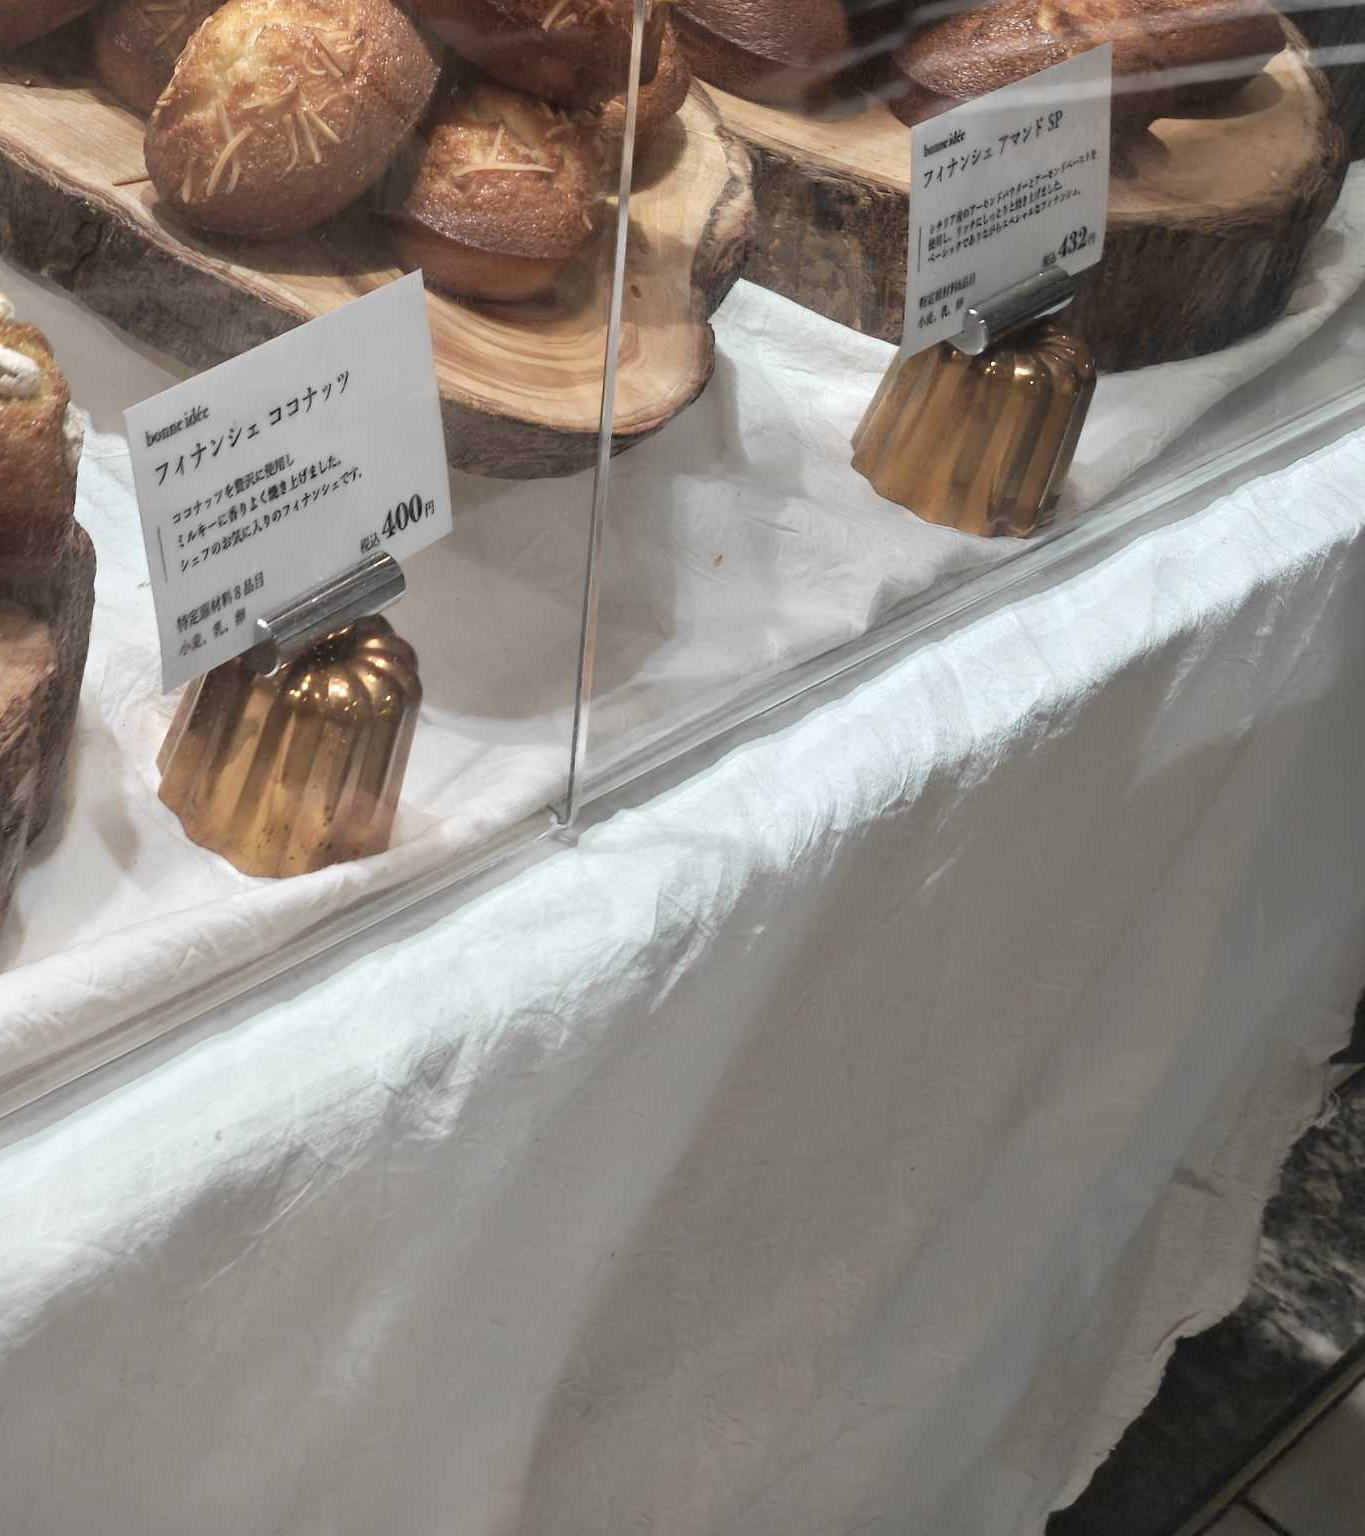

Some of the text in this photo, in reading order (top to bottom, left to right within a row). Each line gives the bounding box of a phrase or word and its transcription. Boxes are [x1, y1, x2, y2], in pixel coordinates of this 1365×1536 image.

[153, 369, 350, 487] フィナンシェ ココナッツ
